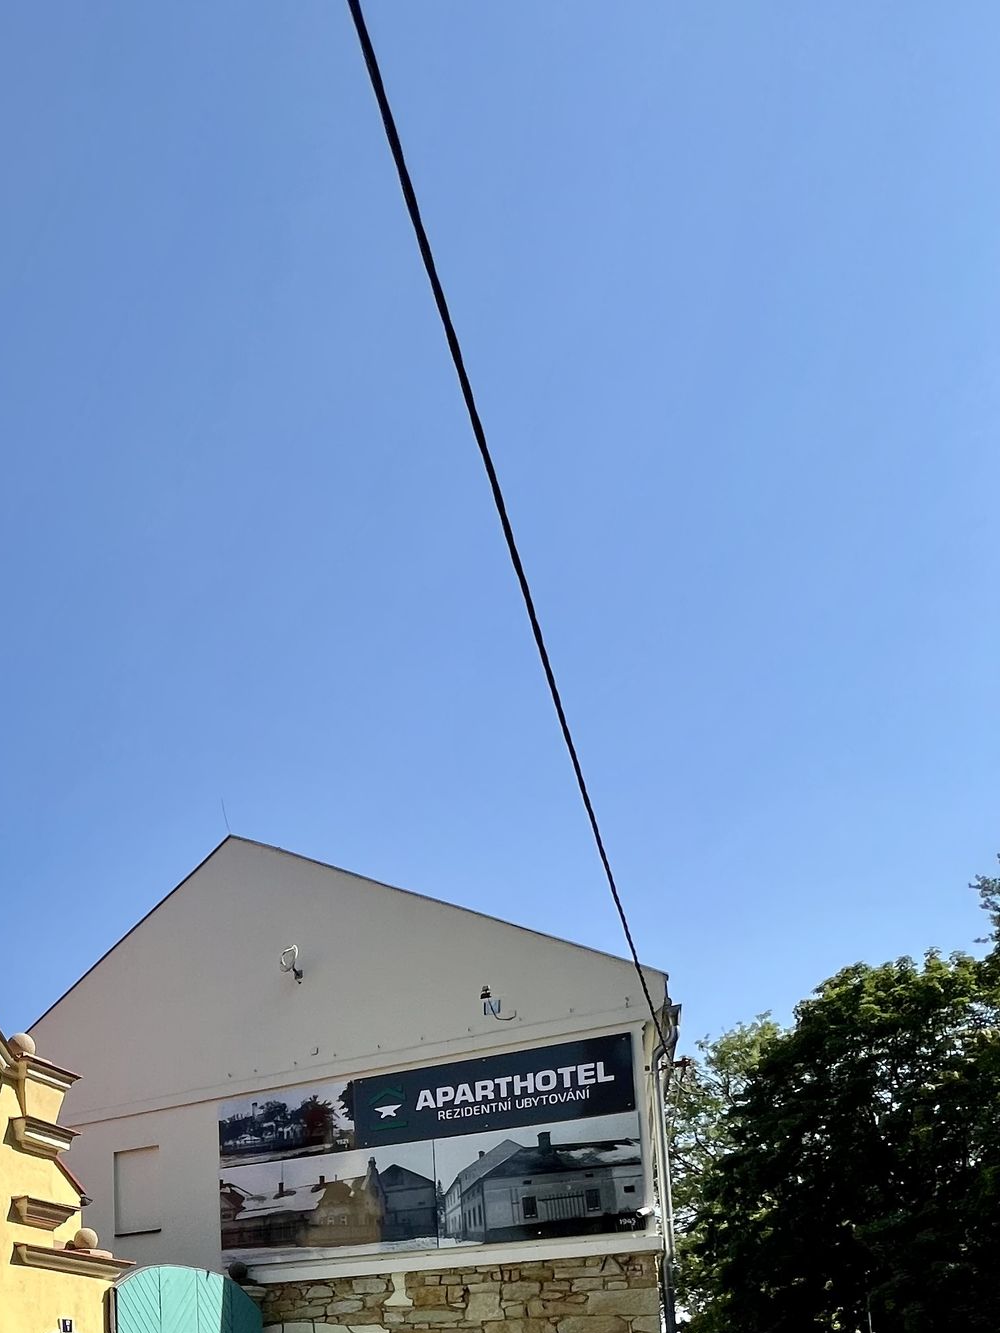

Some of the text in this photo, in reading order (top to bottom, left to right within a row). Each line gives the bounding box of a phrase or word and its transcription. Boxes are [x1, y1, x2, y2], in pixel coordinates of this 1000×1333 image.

[415, 1062, 615, 1111] APARTHOTEL
[438, 1086, 590, 1121] REZIDENTNÍ UBYTOVÁNÍ
